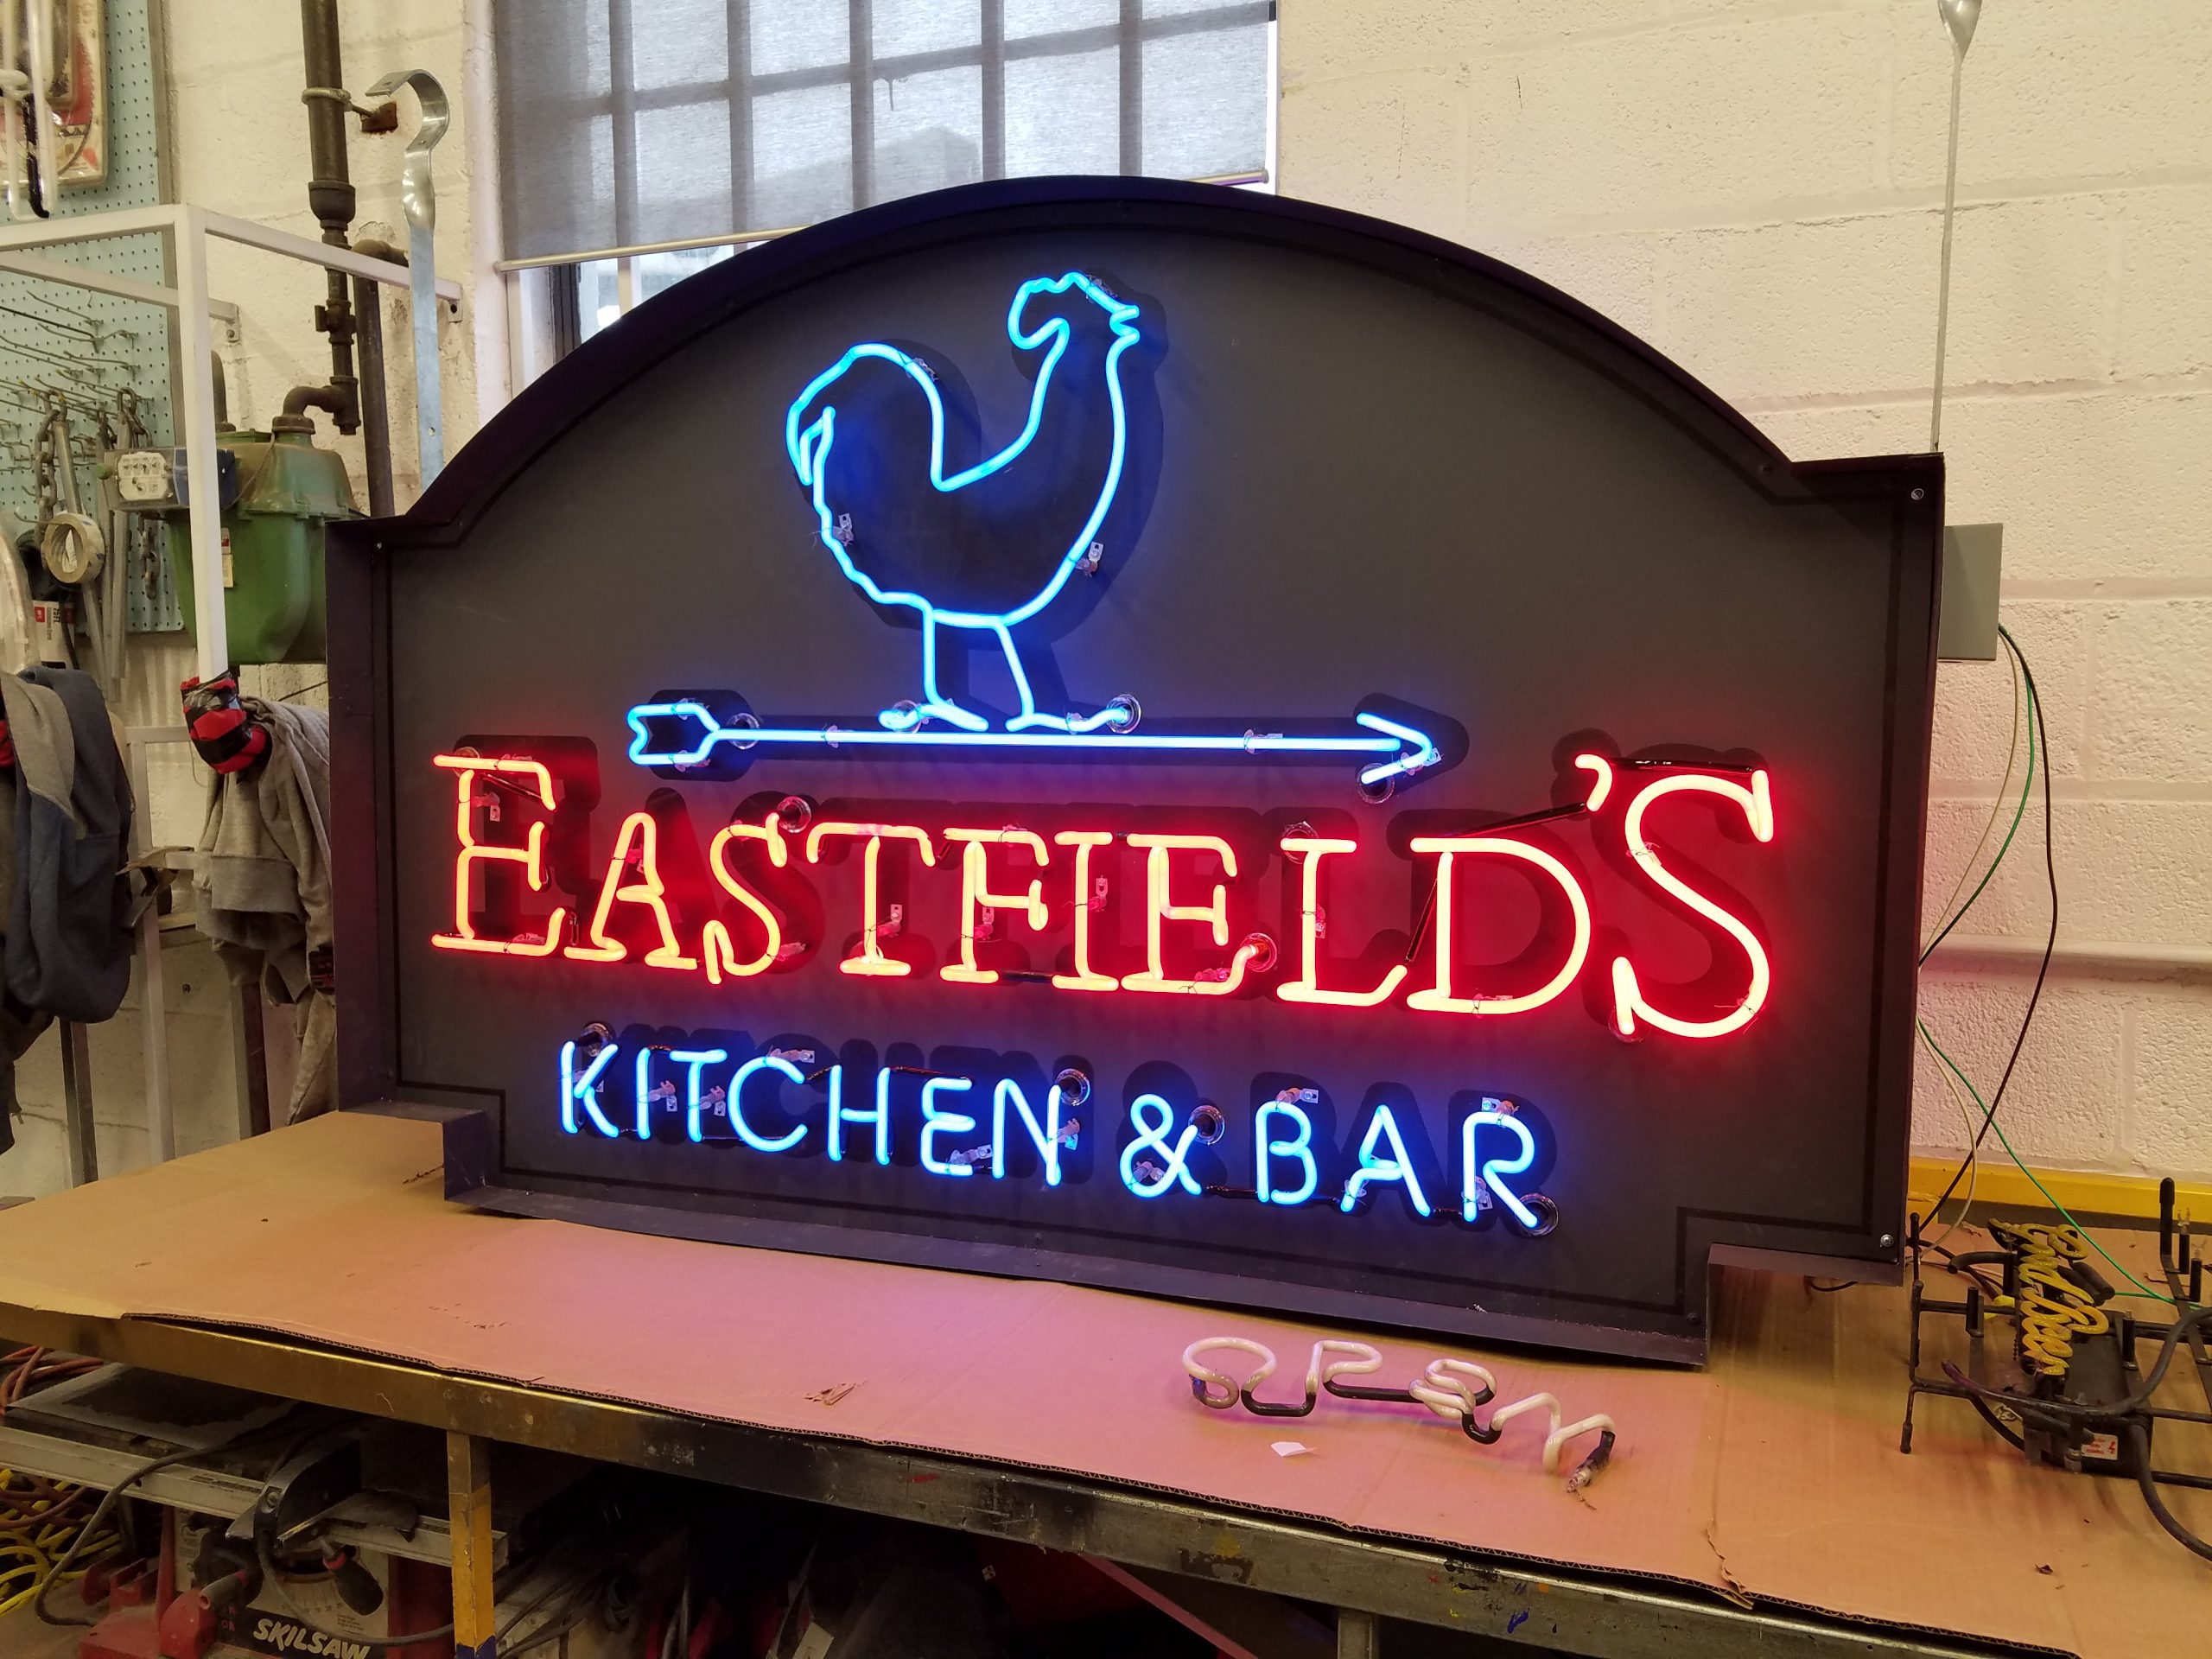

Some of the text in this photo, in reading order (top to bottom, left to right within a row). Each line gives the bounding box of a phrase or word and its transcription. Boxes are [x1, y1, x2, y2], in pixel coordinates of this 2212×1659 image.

[432, 751, 1775, 1039] EASTFIELD'S
[559, 1039, 1539, 1230] KITCHEN & BAR
[253, 1618, 371, 1659] SKILSAW
